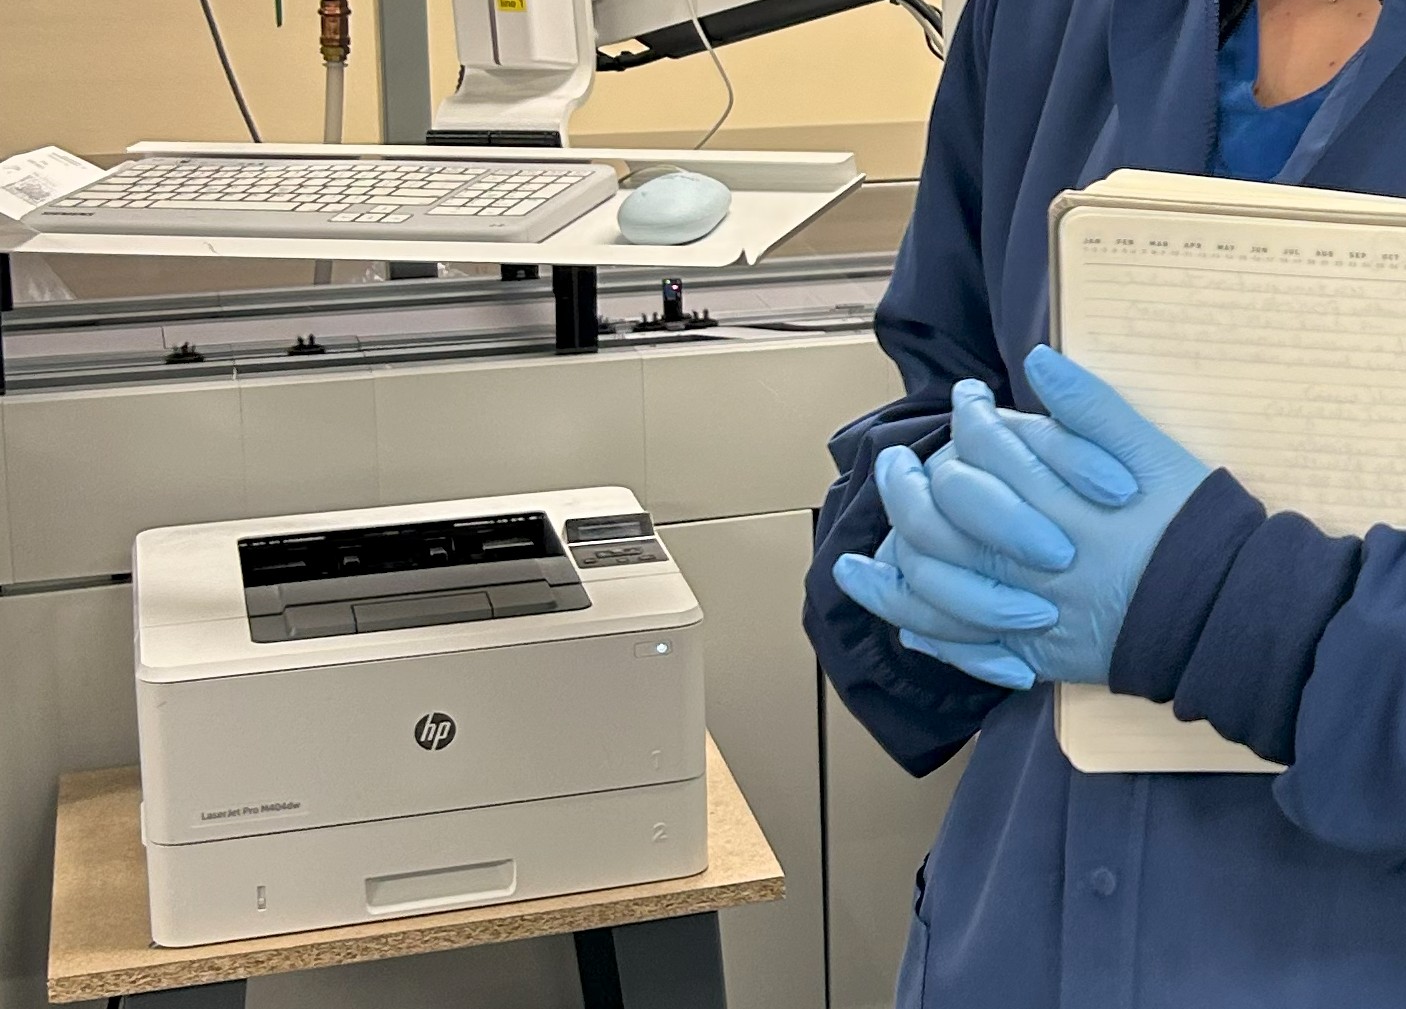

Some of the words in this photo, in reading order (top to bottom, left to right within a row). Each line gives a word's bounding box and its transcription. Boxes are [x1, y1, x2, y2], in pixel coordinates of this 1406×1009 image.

[418, 711, 453, 752] hp
[201, 808, 241, 821] LaserJet
[242, 806, 259, 815] Pro
[652, 822, 668, 842] 2
